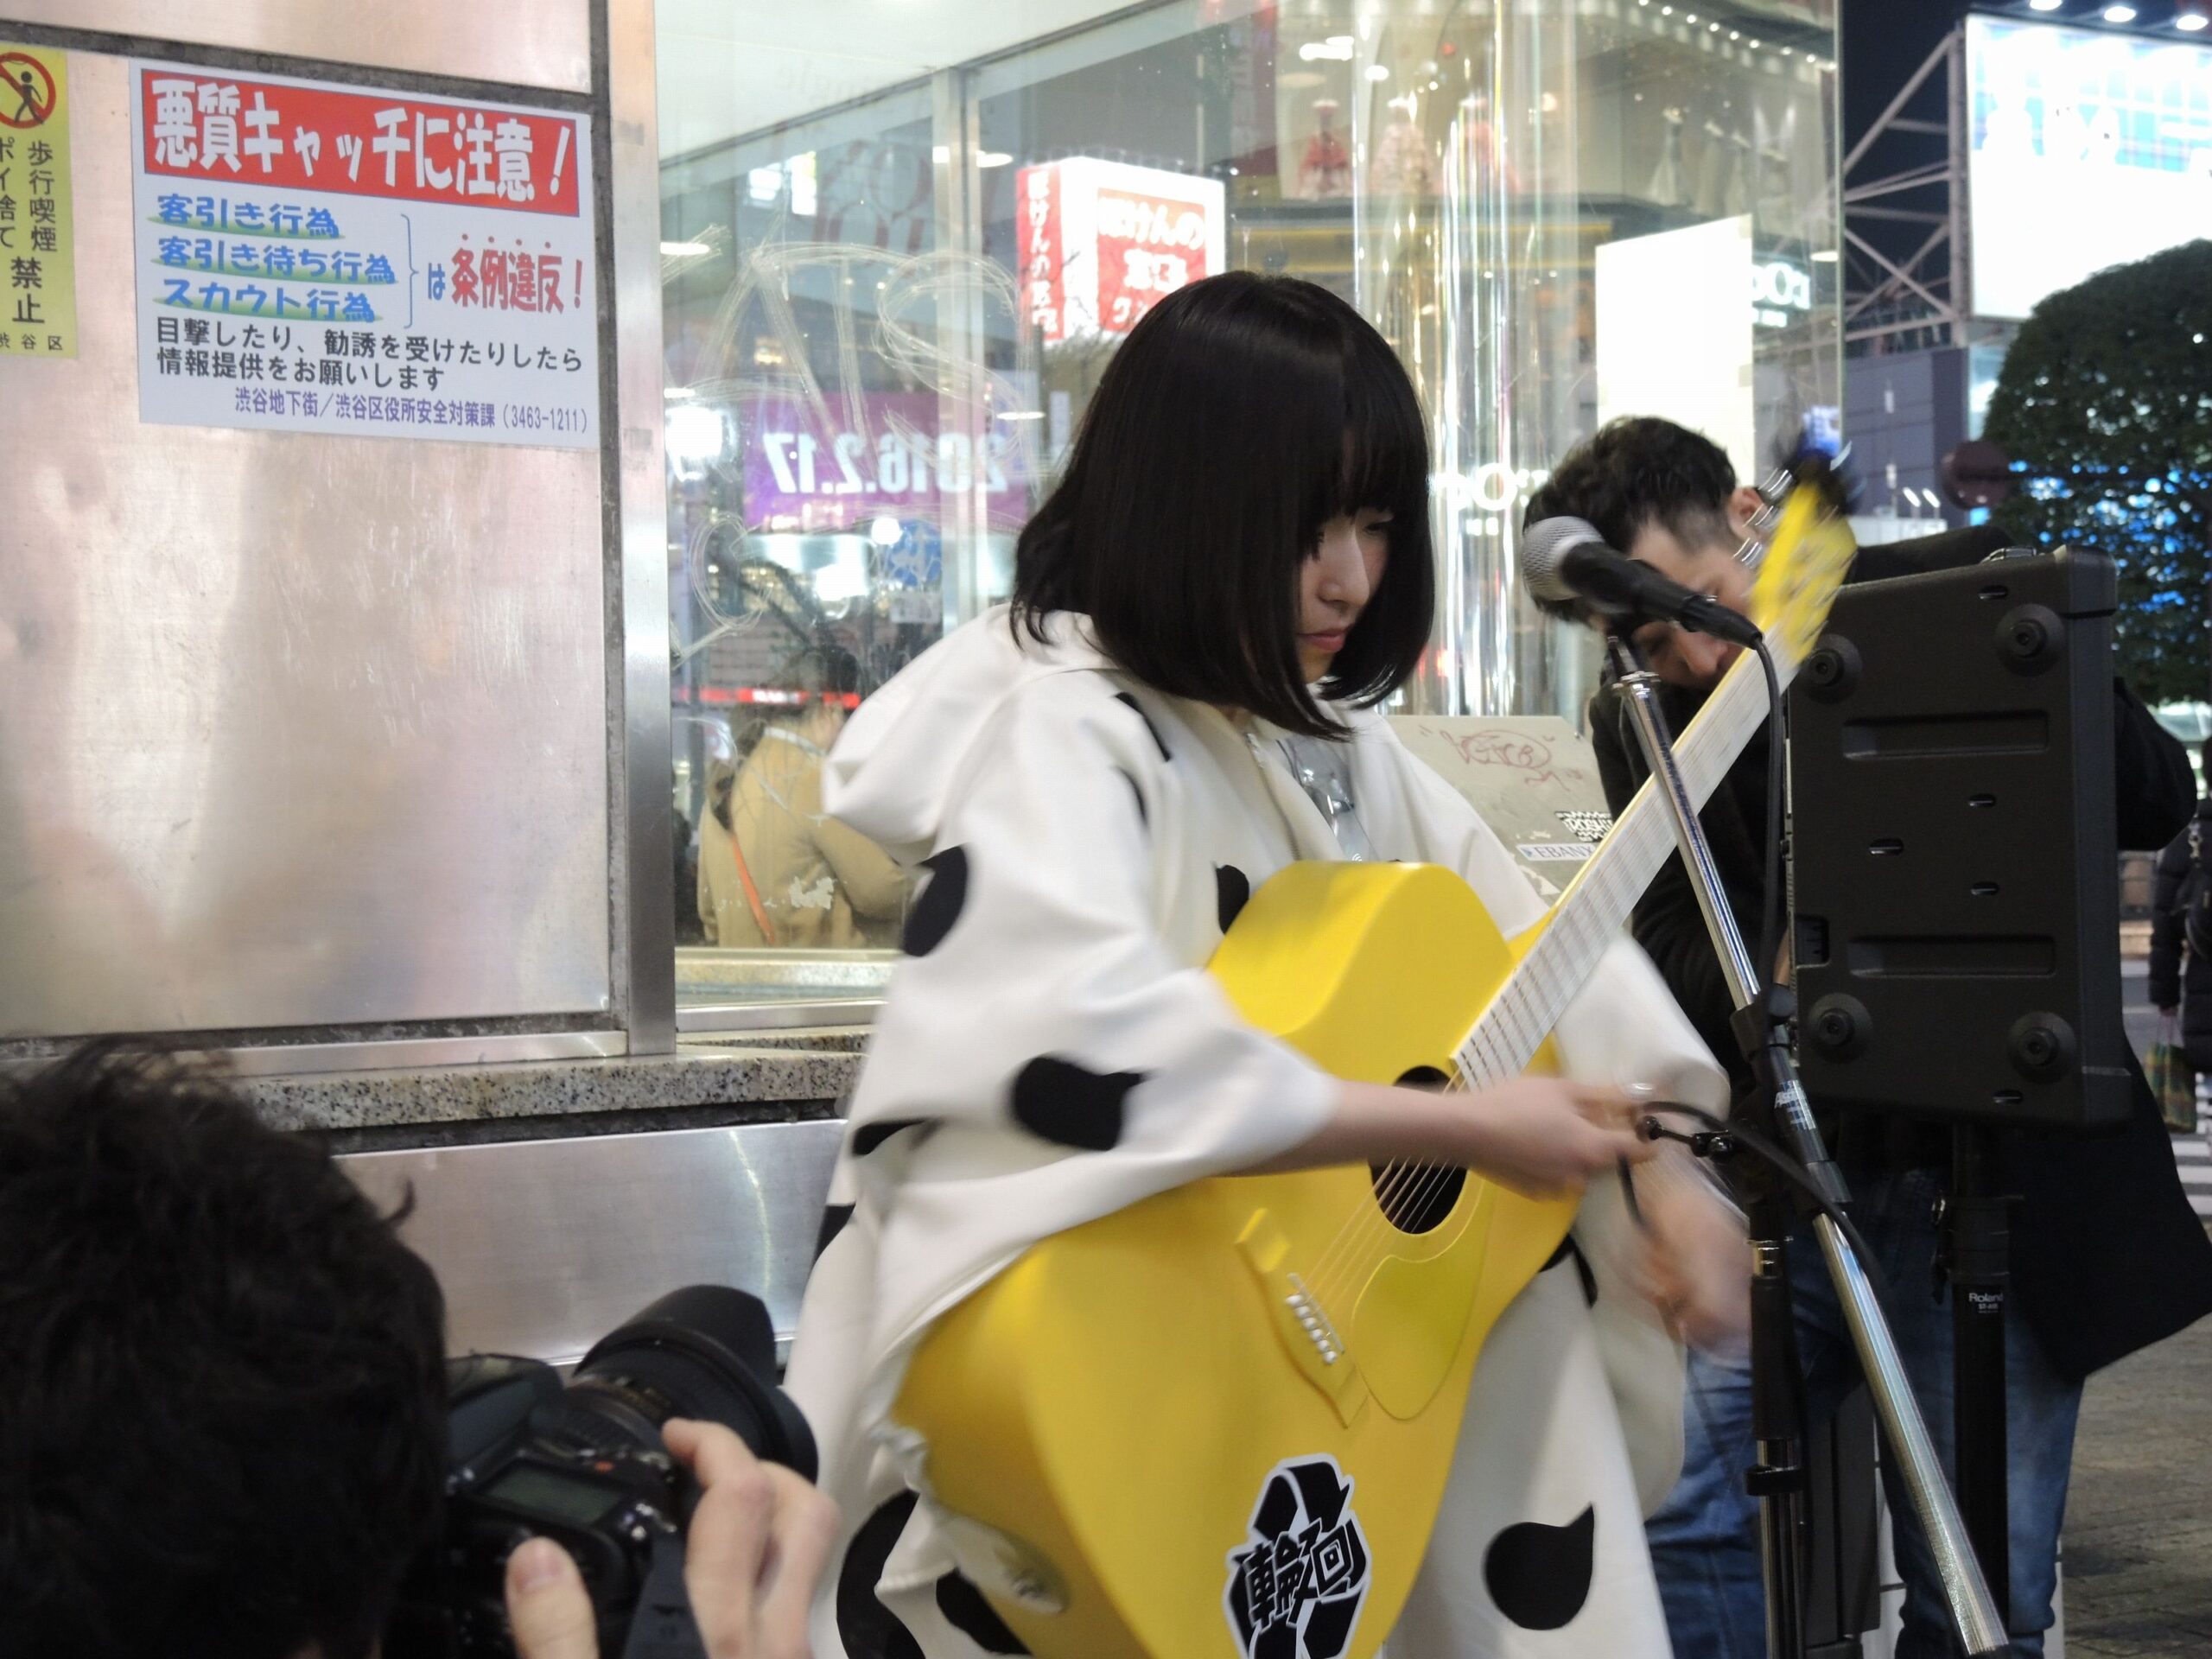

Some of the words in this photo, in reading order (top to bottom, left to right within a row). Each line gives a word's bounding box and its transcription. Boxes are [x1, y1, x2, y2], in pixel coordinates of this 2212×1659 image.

[152, 79, 570, 202] 悪質キャッチに注意！
[28, 140, 58, 252] 歩行喫煙
[157, 194, 340, 238] 客引き行為
[158, 236, 396, 284] 客引き待ち行為
[11, 257, 45, 324] 禁止
[163, 279, 375, 323] スカウト行為
[157, 346, 444, 391] 情報提供をお願いします
[1968, 1292, 2004, 1303] Roland
